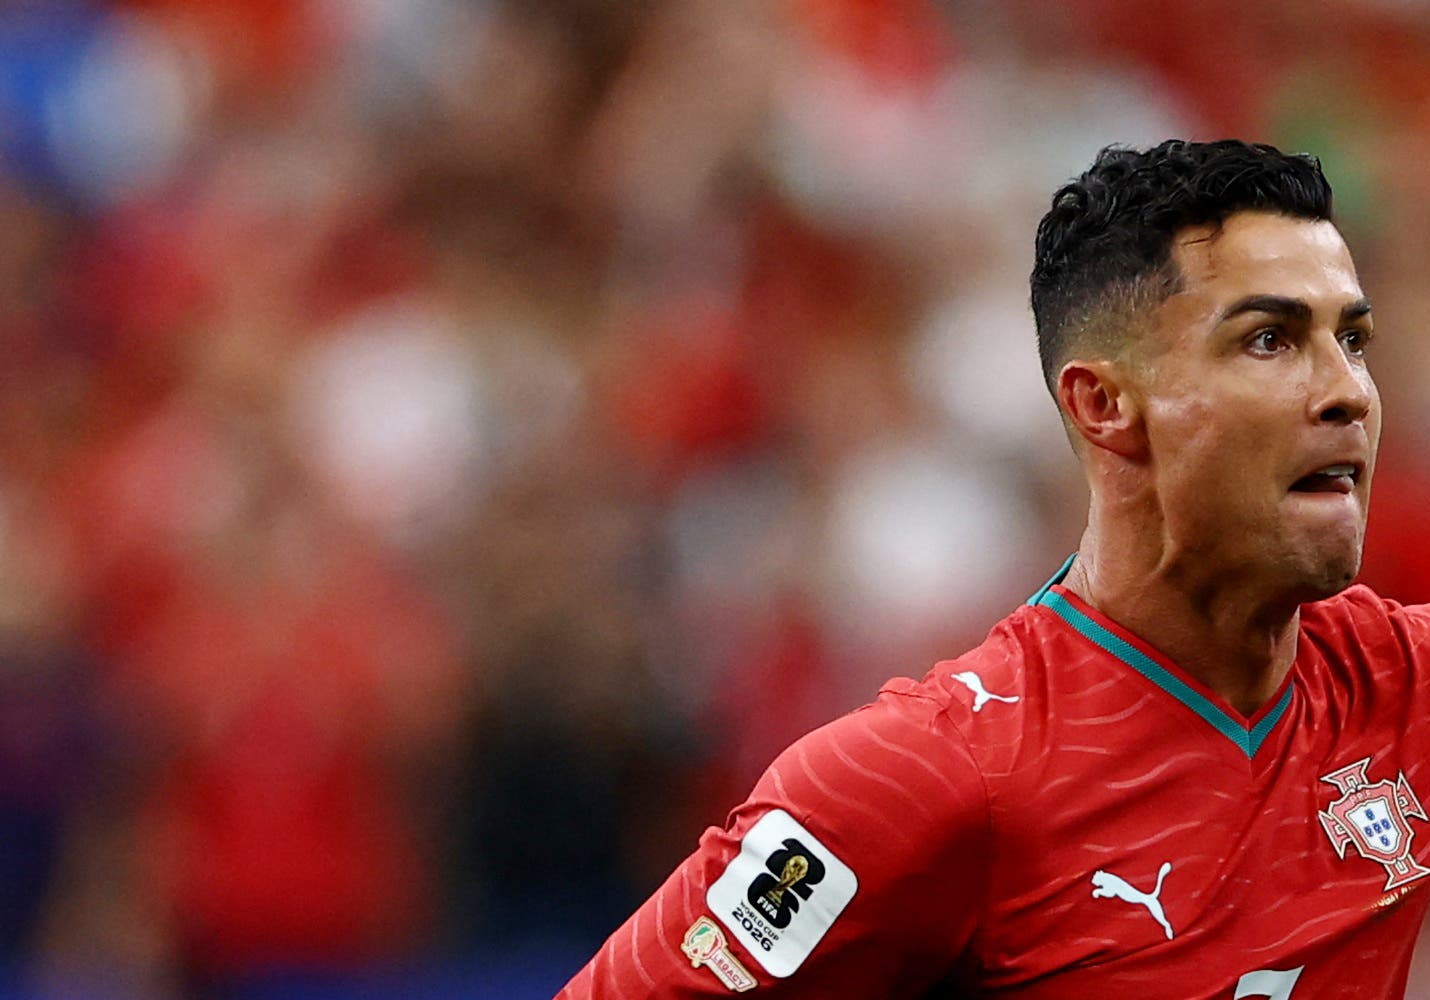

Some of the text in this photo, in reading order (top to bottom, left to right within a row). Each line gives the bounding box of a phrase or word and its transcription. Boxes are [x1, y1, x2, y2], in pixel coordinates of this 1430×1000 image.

[740, 899, 779, 941] WORLD CUP
[756, 895, 778, 919] FIFA
[731, 906, 774, 952] 2026
[712, 953, 744, 986] LEGACY
